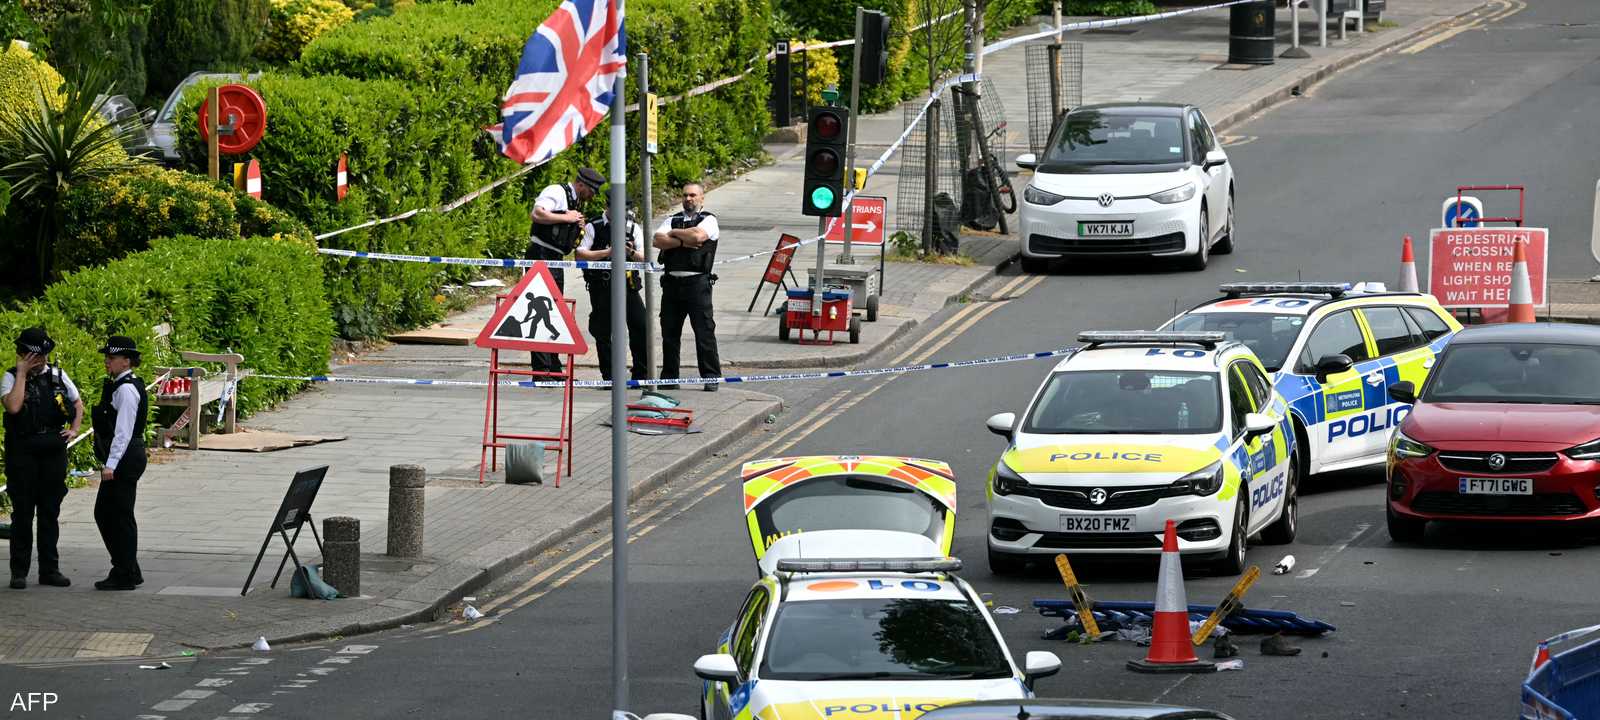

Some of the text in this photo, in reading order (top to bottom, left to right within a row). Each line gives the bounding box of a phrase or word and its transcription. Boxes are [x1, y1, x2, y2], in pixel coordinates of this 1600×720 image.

[852, 205, 882, 214] TRIANS
[1087, 224, 1130, 234] VK71 KJA
[1447, 234, 1530, 245] PEDESTRIAN
[1452, 246, 1513, 257] CROSSIN
[1453, 262, 1513, 272] WHEN RE
[1443, 275, 1512, 286] LIGHT SHO
[1446, 288, 1512, 301] WAIT HE
[1341, 400, 1358, 408] POLICE
[1328, 404, 1413, 443] POLIC
[1050, 452, 1163, 462] POLICE
[1470, 479, 1527, 492] FT71 GWG
[1252, 471, 1284, 512] POLICE
[1066, 517, 1130, 530] BX20 FMZ
[824, 703, 940, 716] POLIC
